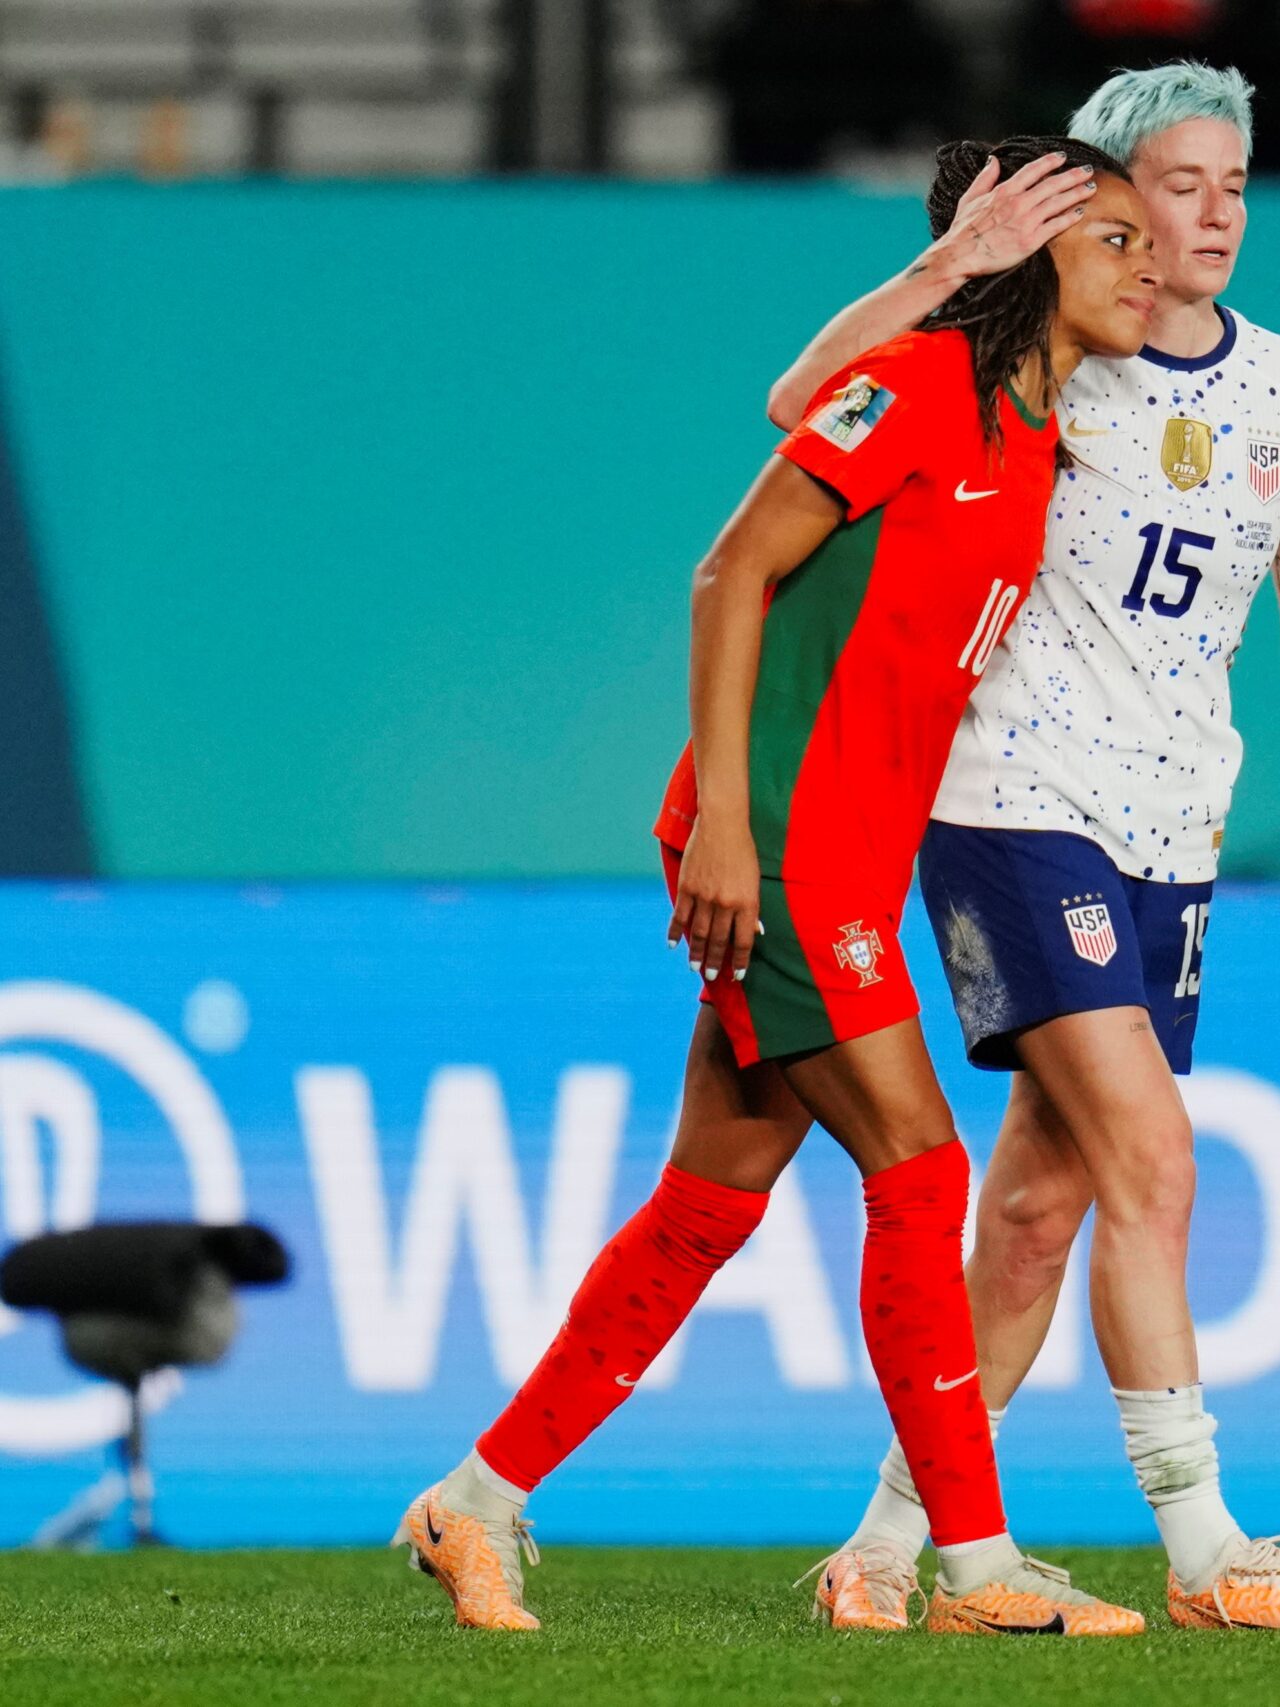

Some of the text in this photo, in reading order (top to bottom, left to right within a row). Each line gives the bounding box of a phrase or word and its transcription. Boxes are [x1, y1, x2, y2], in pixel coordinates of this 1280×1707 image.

[1249, 443, 1279, 468] USA
[1173, 463, 1197, 475] FIFA
[1121, 522, 1216, 618] 15
[957, 578, 1019, 676] 10
[1069, 908, 1107, 931] USA
